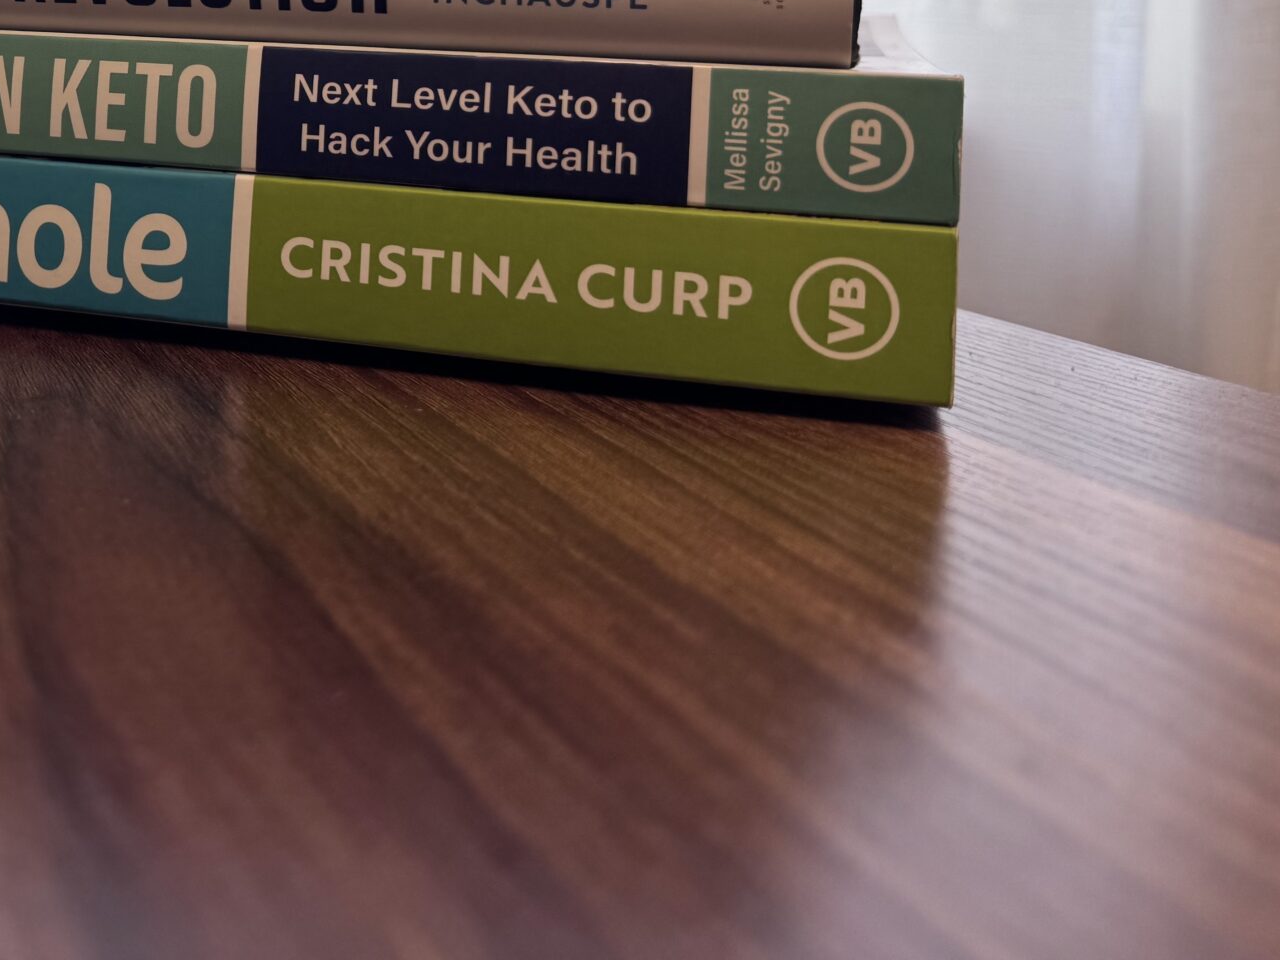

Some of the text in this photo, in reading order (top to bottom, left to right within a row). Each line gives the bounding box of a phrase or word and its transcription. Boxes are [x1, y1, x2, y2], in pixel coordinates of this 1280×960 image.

[48, 57, 218, 149] KETO
[292, 72, 653, 124] Next Level Keto to
[299, 123, 639, 177] Hack Your Health
[722, 86, 751, 193] Mellissa
[758, 90, 792, 193] Sevigny
[847, 116, 882, 176] VB
[279, 235, 754, 320] CRISTINA CURP
[826, 276, 868, 345] VB
